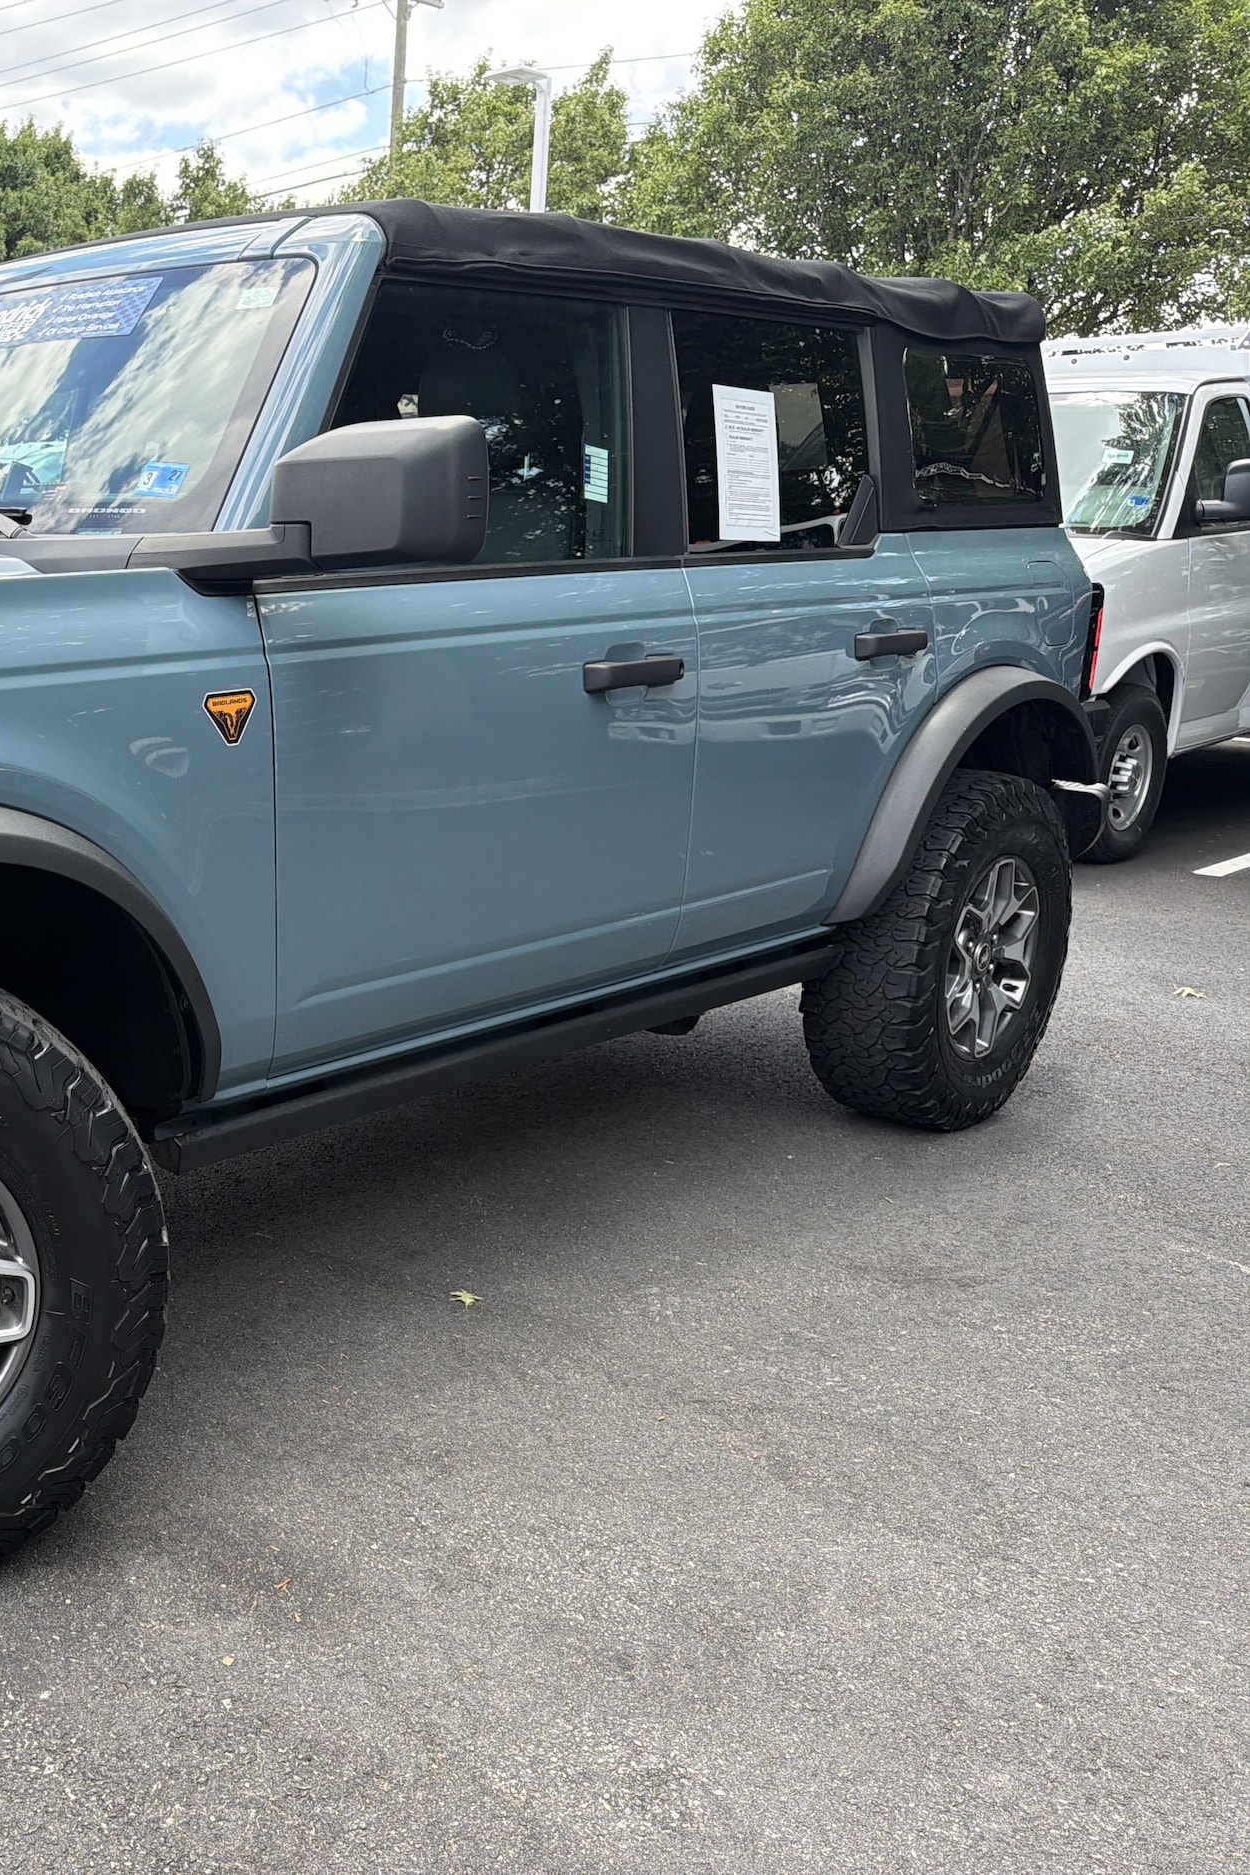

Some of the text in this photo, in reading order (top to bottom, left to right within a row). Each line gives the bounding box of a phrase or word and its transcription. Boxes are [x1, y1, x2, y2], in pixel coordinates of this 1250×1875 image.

[142, 472, 154, 486] 3
[167, 469, 183, 482] 27
[212, 698, 248, 707] BADLANDS
